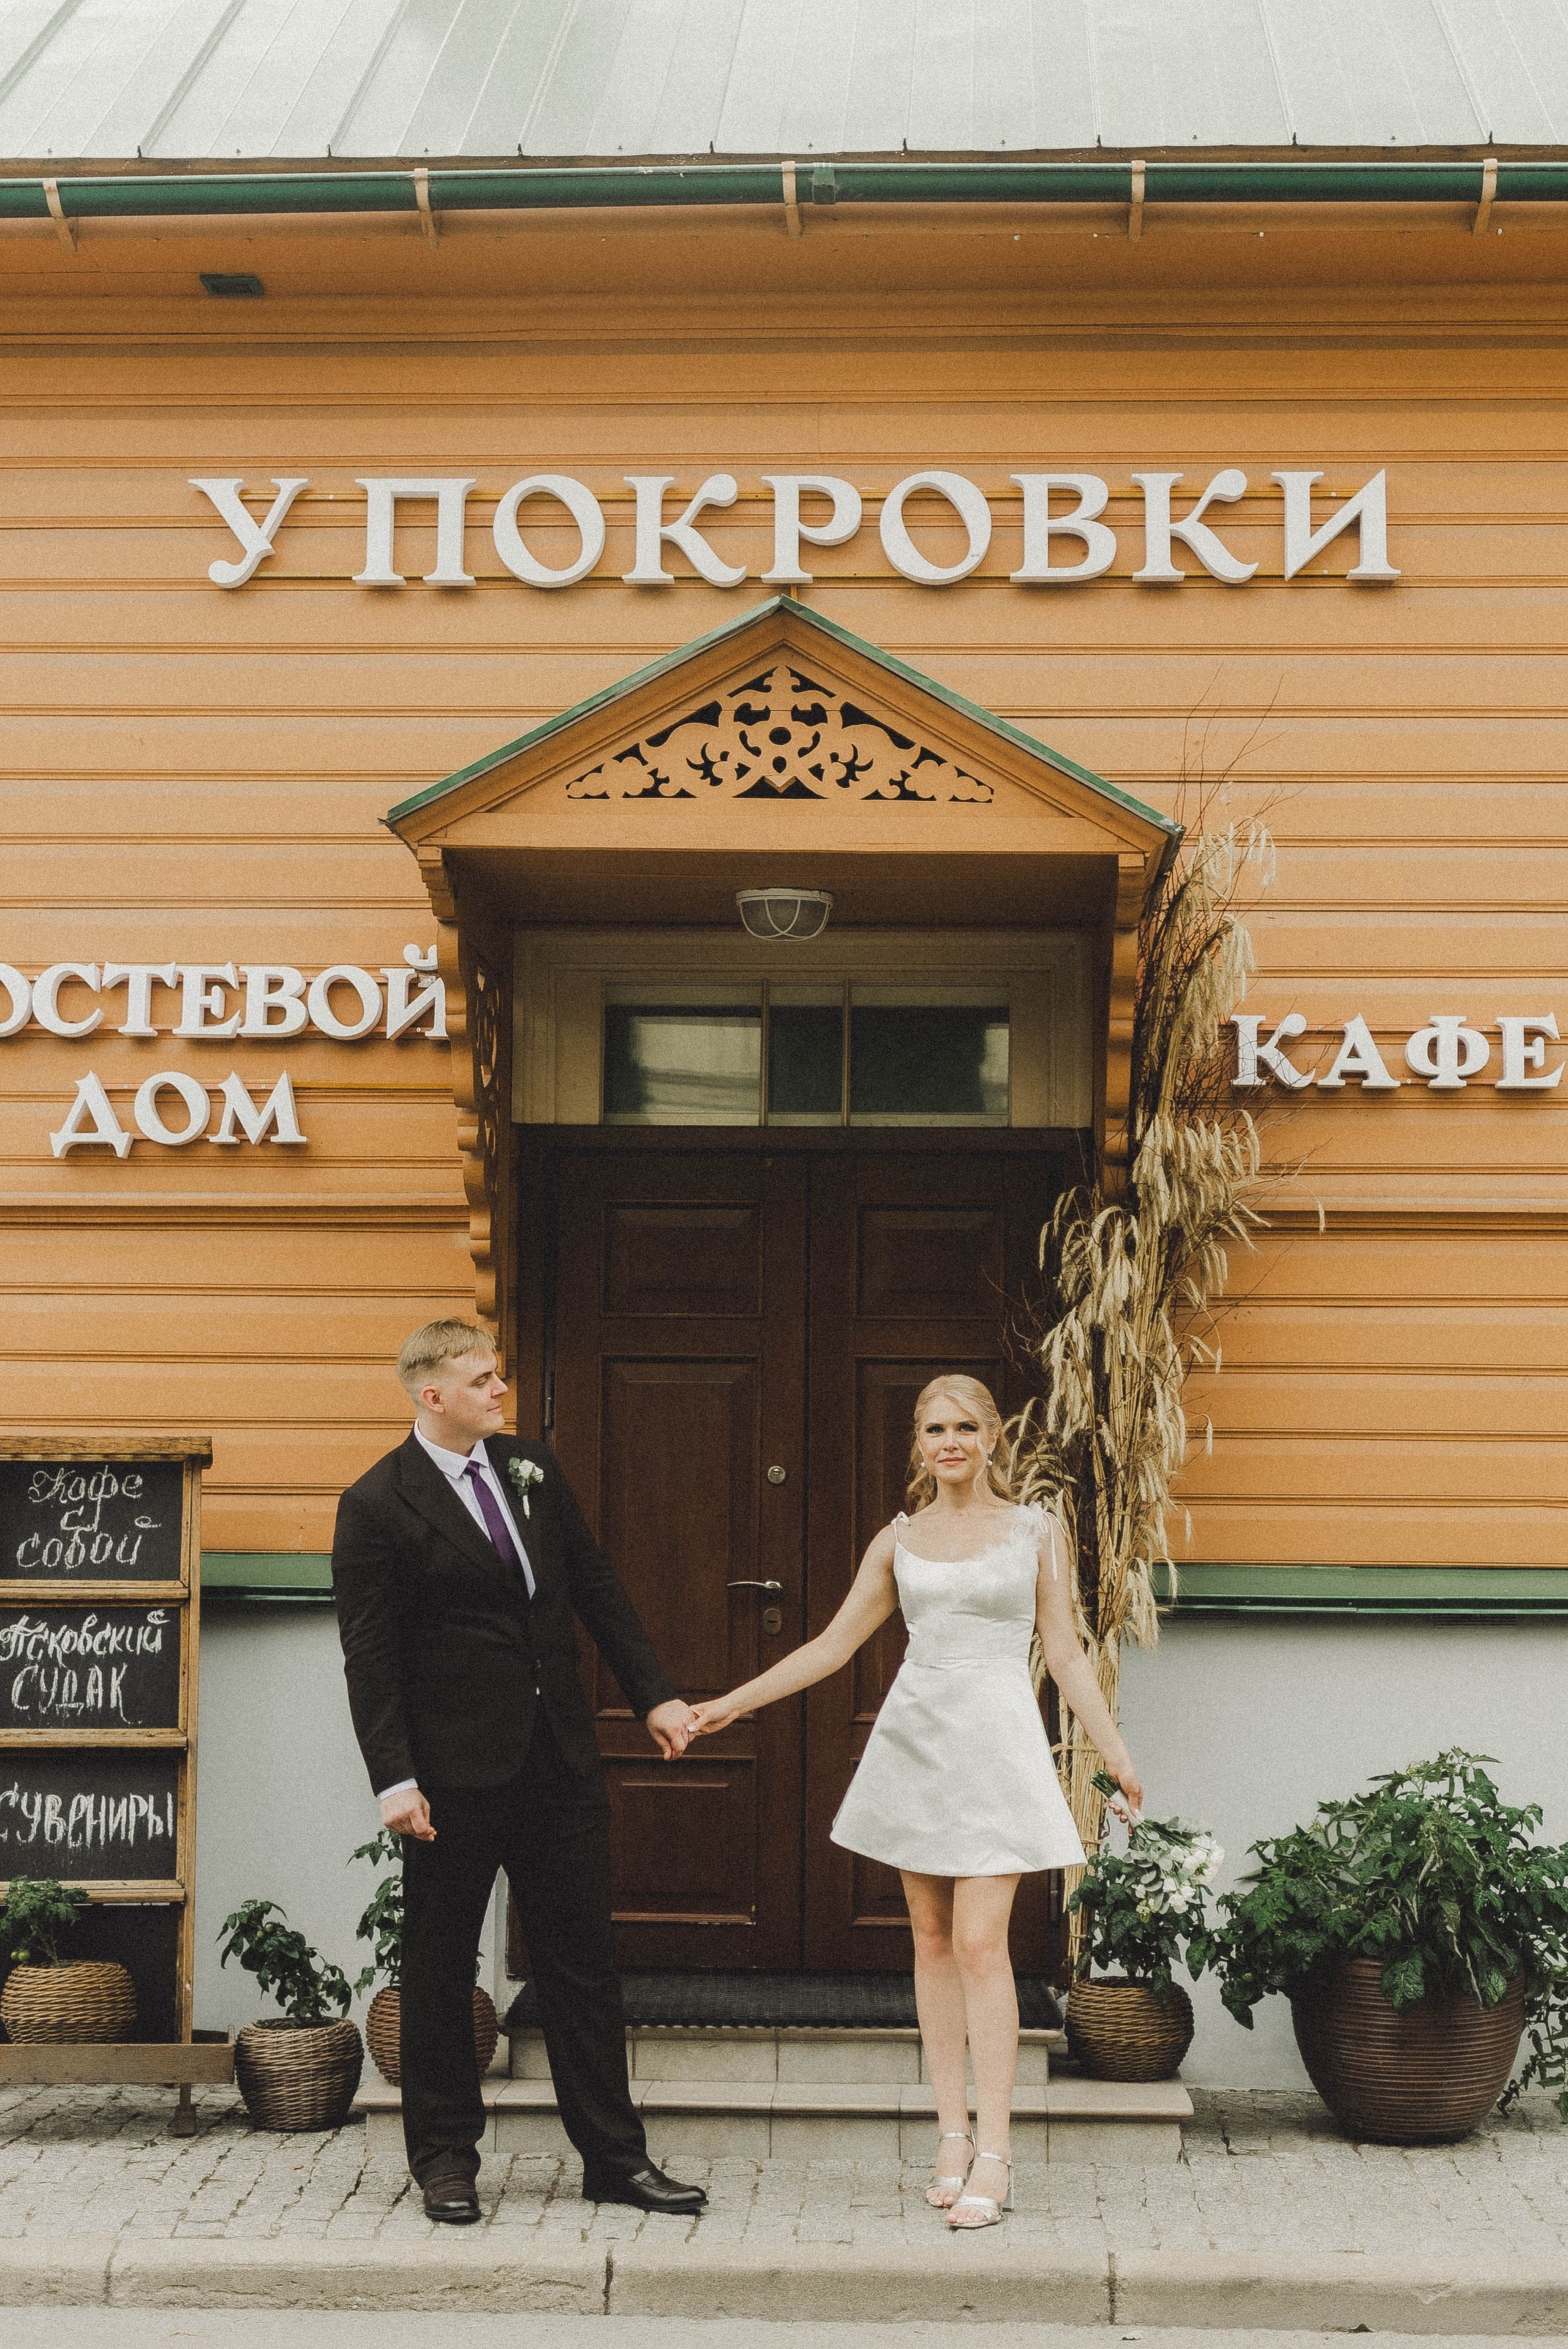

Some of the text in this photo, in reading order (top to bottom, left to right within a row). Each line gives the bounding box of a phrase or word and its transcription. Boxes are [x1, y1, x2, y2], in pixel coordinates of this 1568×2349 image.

[188, 468, 1401, 589] У ПОКРОВКИ
[1230, 1011, 1566, 1090] КАФЕ
[49, 1070, 307, 1159] ДОМ
